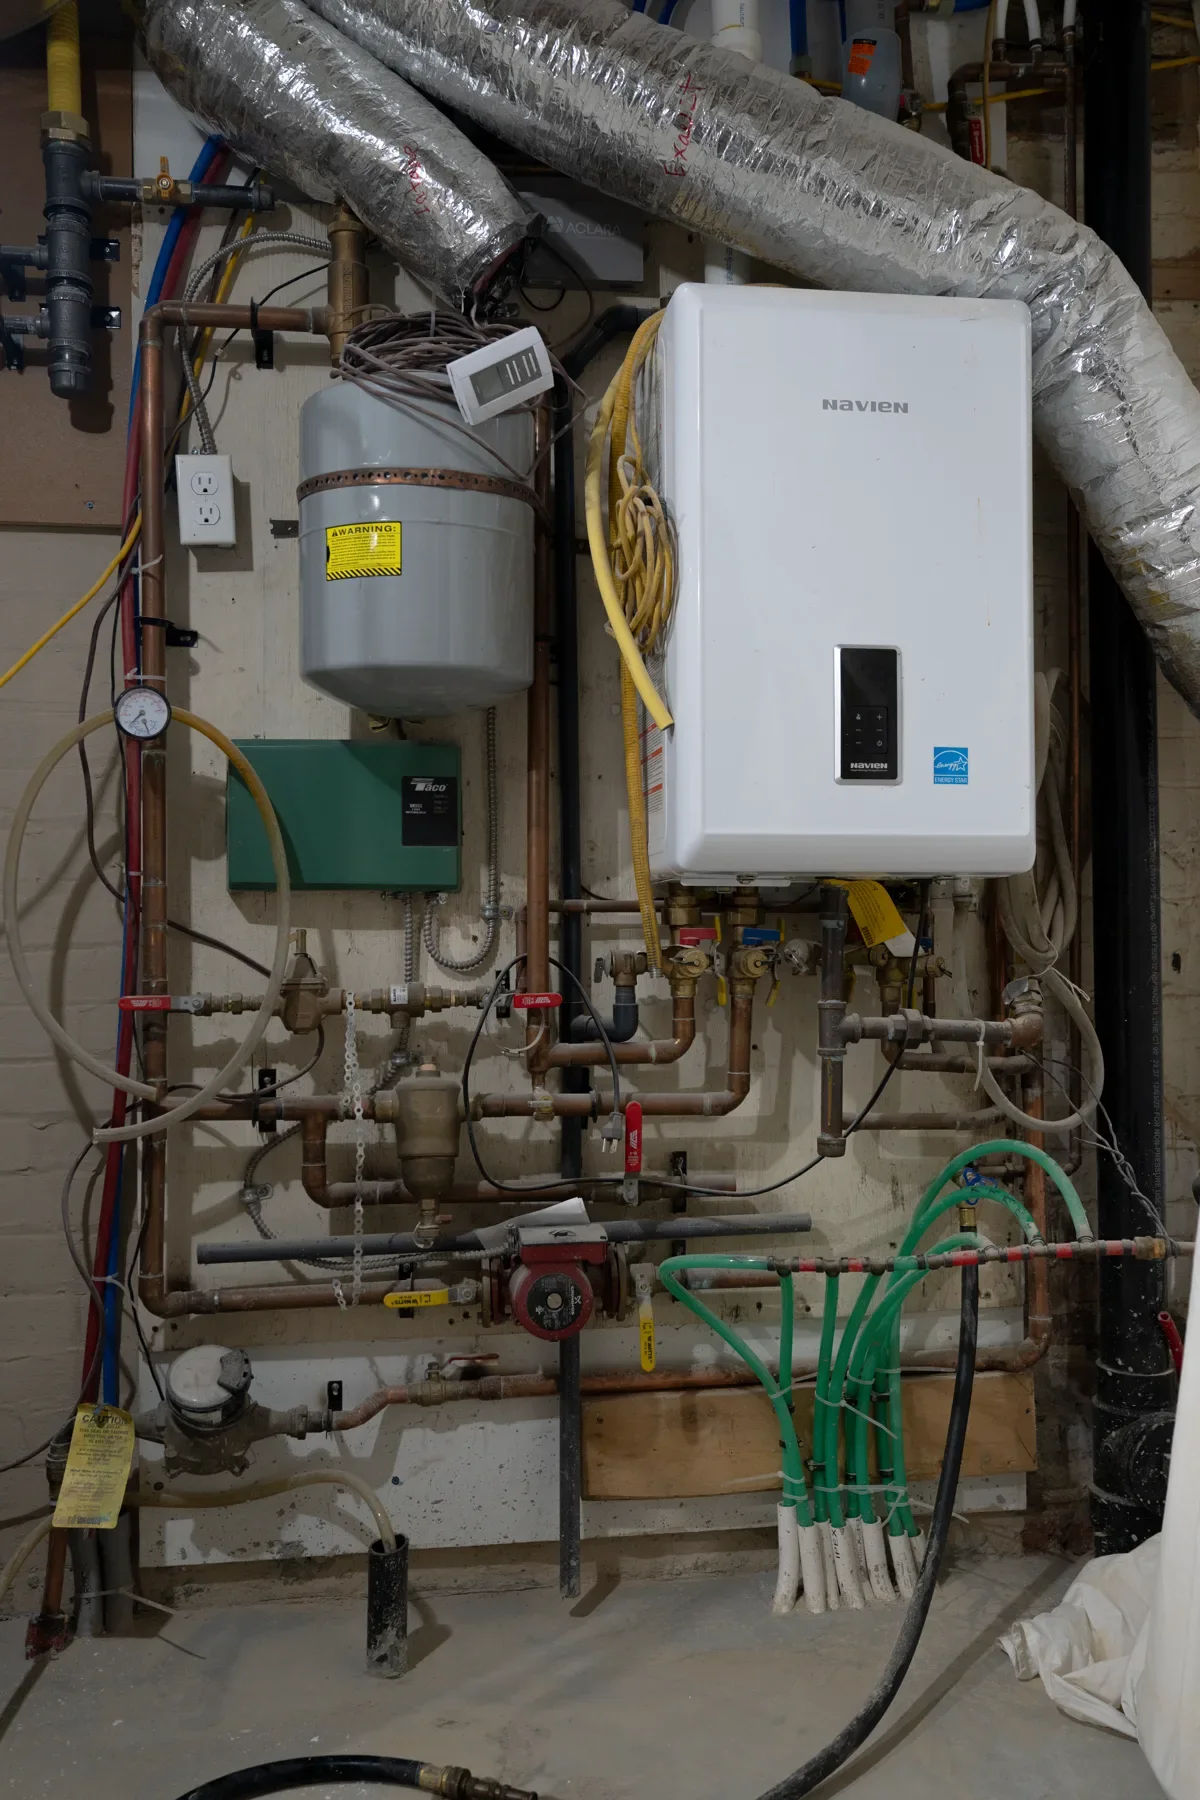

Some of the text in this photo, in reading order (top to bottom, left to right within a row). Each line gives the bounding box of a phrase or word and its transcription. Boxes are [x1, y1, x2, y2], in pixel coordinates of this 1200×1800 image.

[564, 221, 622, 236] ACLARA
[339, 525, 396, 536] WARNING:
[82, 1414, 129, 1425] CAUTION
